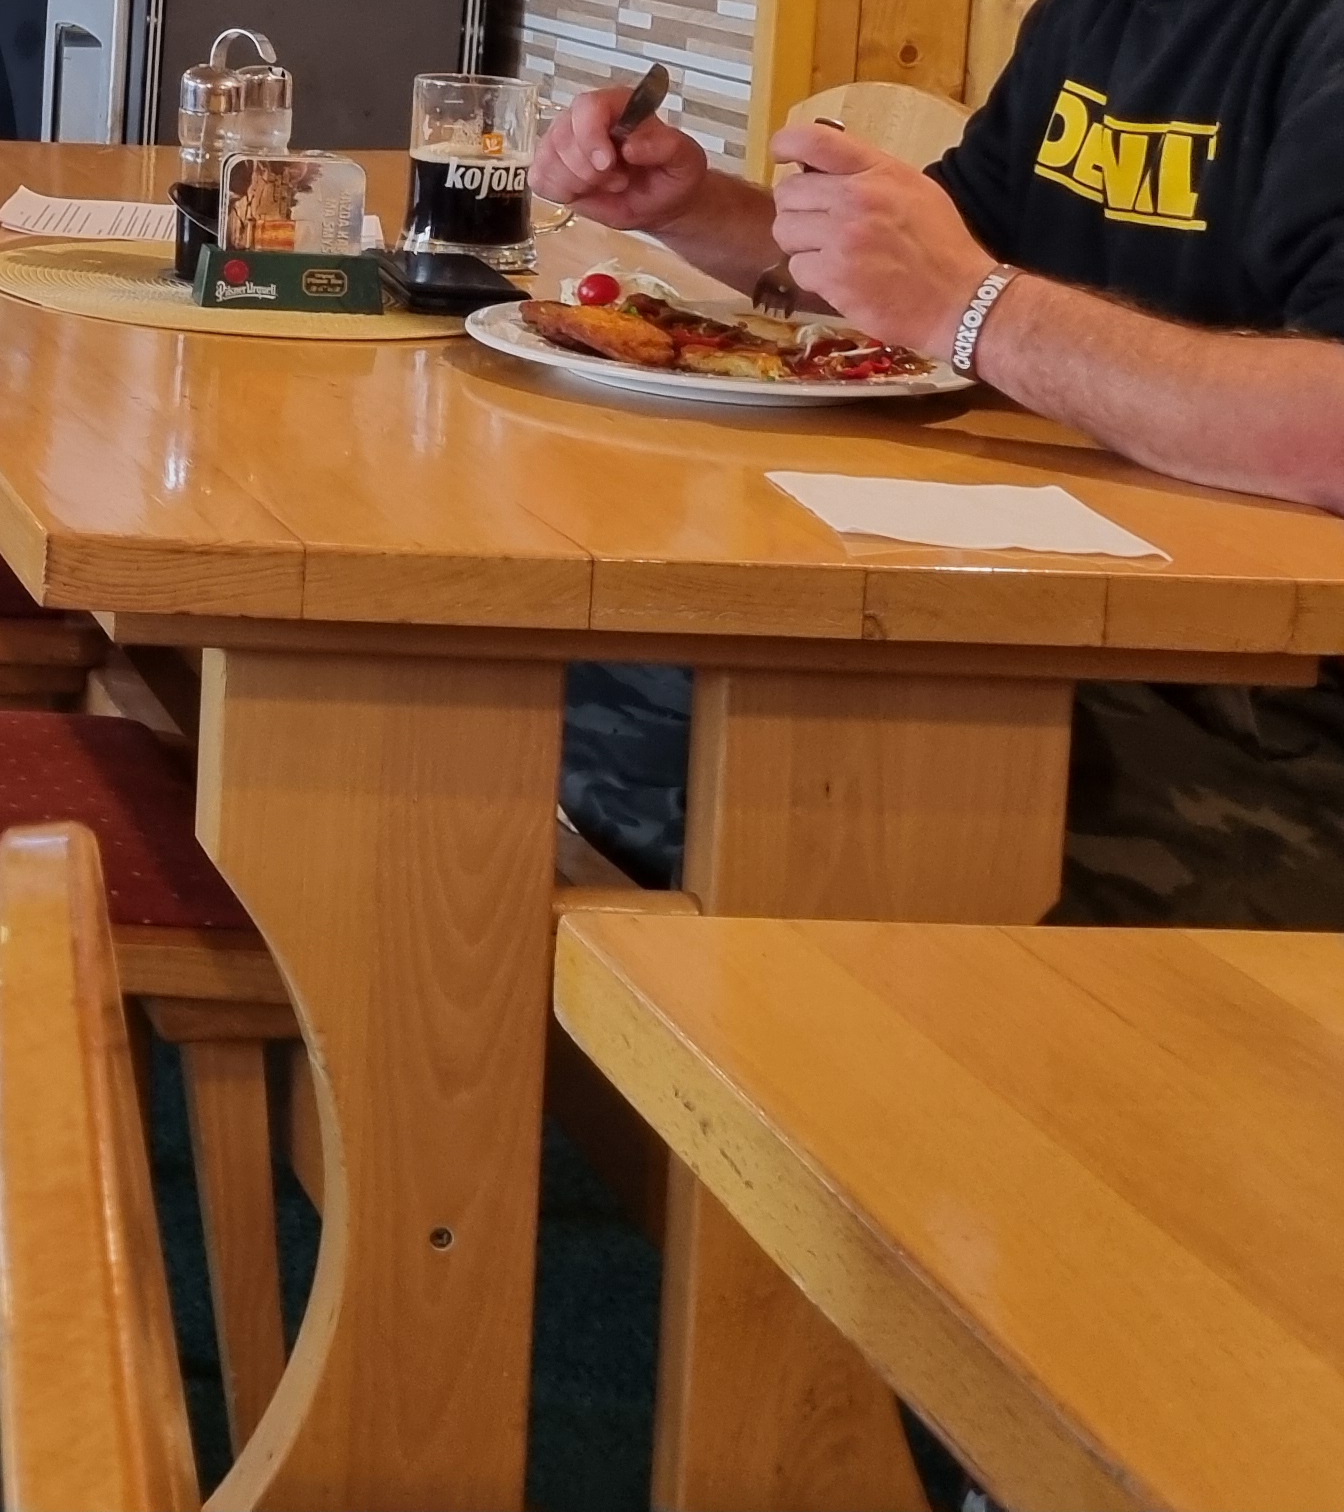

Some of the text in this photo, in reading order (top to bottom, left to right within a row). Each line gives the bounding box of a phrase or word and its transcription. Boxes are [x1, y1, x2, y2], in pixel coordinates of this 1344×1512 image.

[444, 157, 526, 199] kofola
[215, 280, 277, 302] Pilsner Urquell
